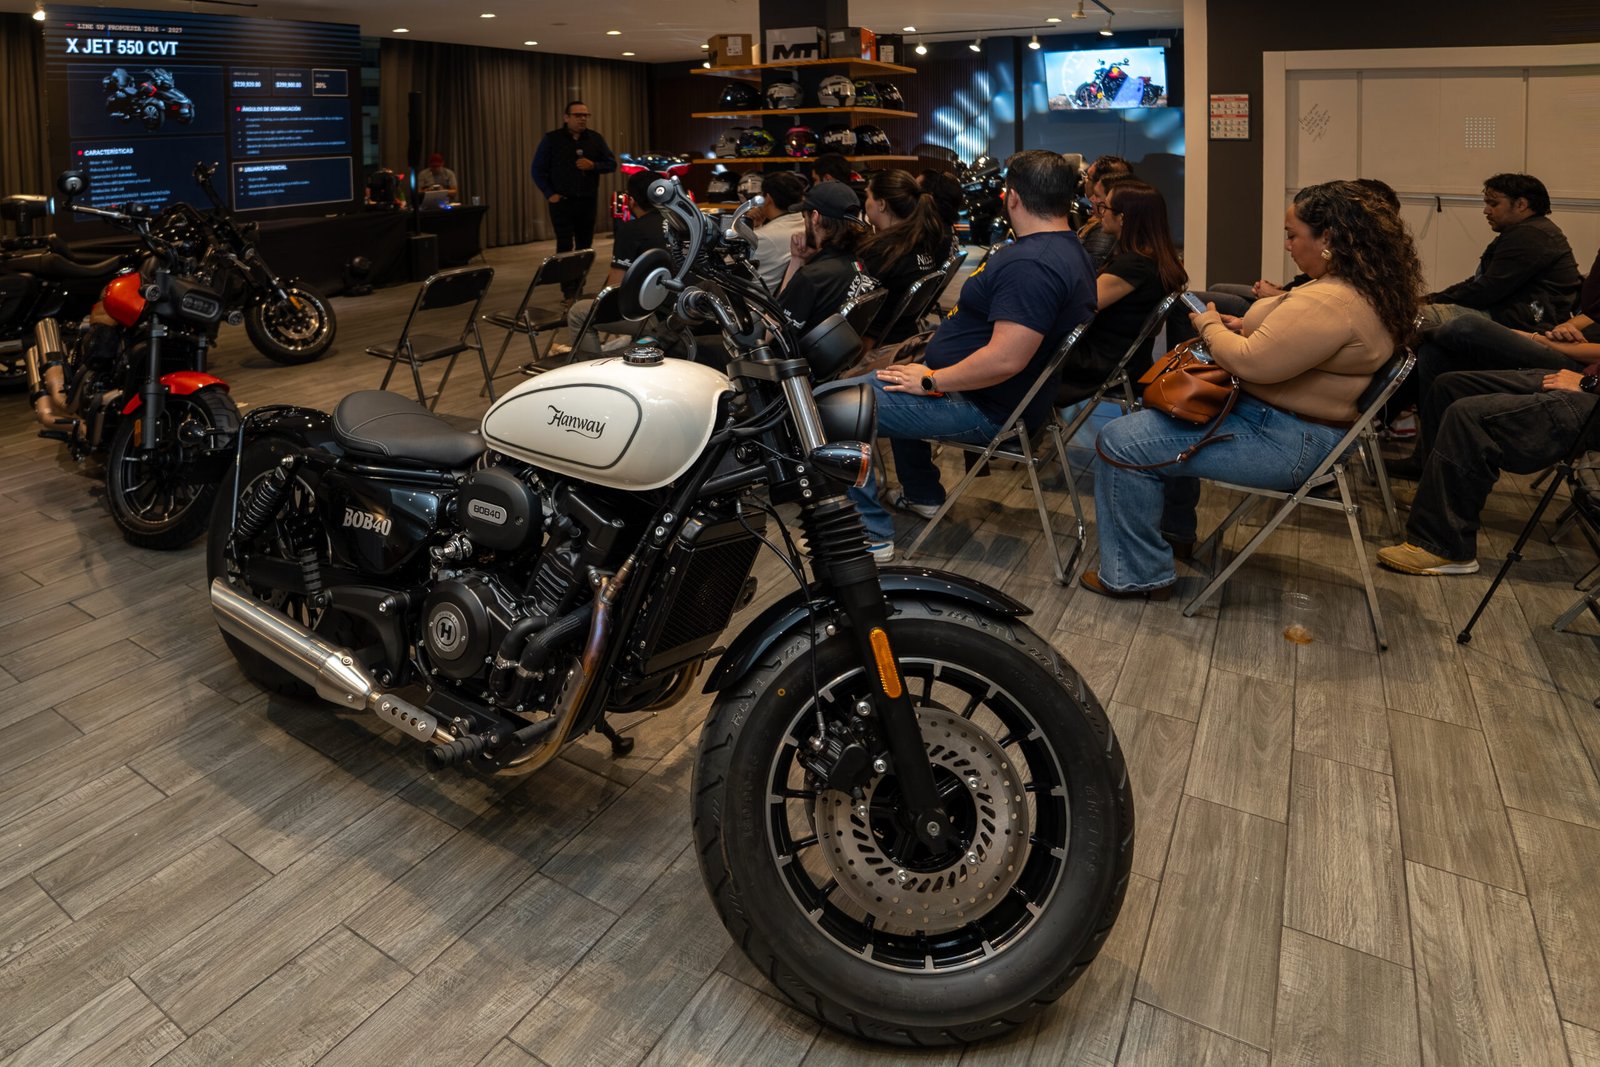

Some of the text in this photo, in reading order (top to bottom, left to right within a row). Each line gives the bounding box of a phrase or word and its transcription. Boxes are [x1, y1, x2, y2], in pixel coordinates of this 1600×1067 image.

[107, 24, 142, 32] PROPUESTA
[66, 38, 179, 56] X JET 550 CVT
[772, 42, 819, 61] MT
[547, 404, 606, 439] Hanway
[473, 504, 501, 520] BOB40
[342, 507, 392, 537] BOB40
[440, 621, 452, 641] H
